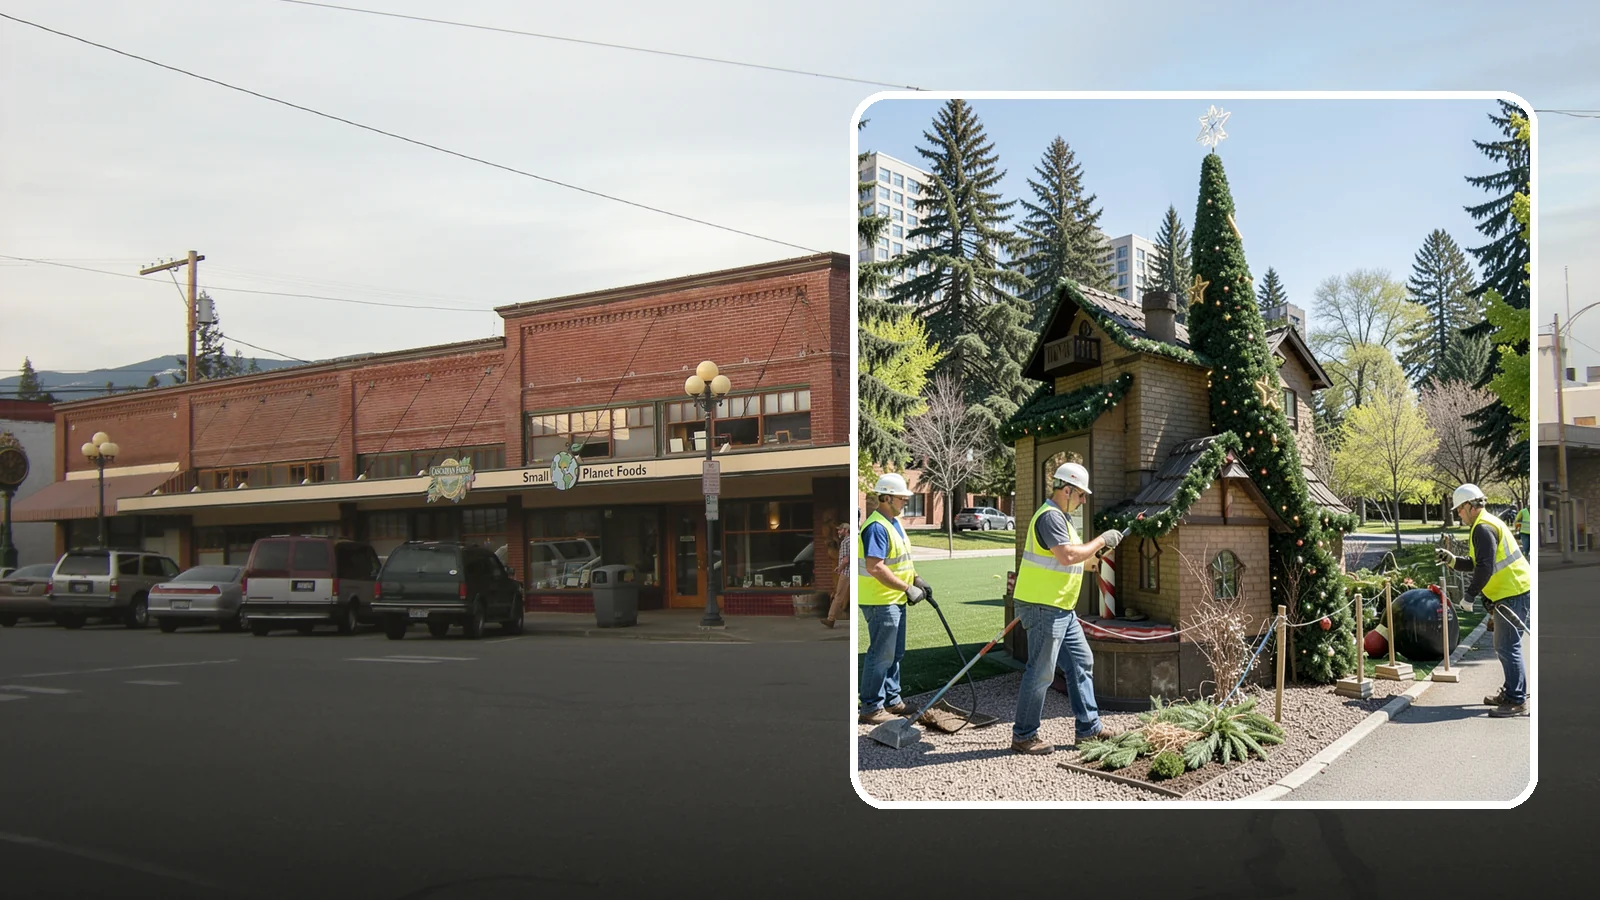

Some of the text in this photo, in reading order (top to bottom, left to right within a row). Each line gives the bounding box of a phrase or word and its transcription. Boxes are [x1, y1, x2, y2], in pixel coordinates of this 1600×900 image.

[431, 465, 470, 476] CASCADIAN FARM
[523, 464, 647, 483] Small Planet Foods
